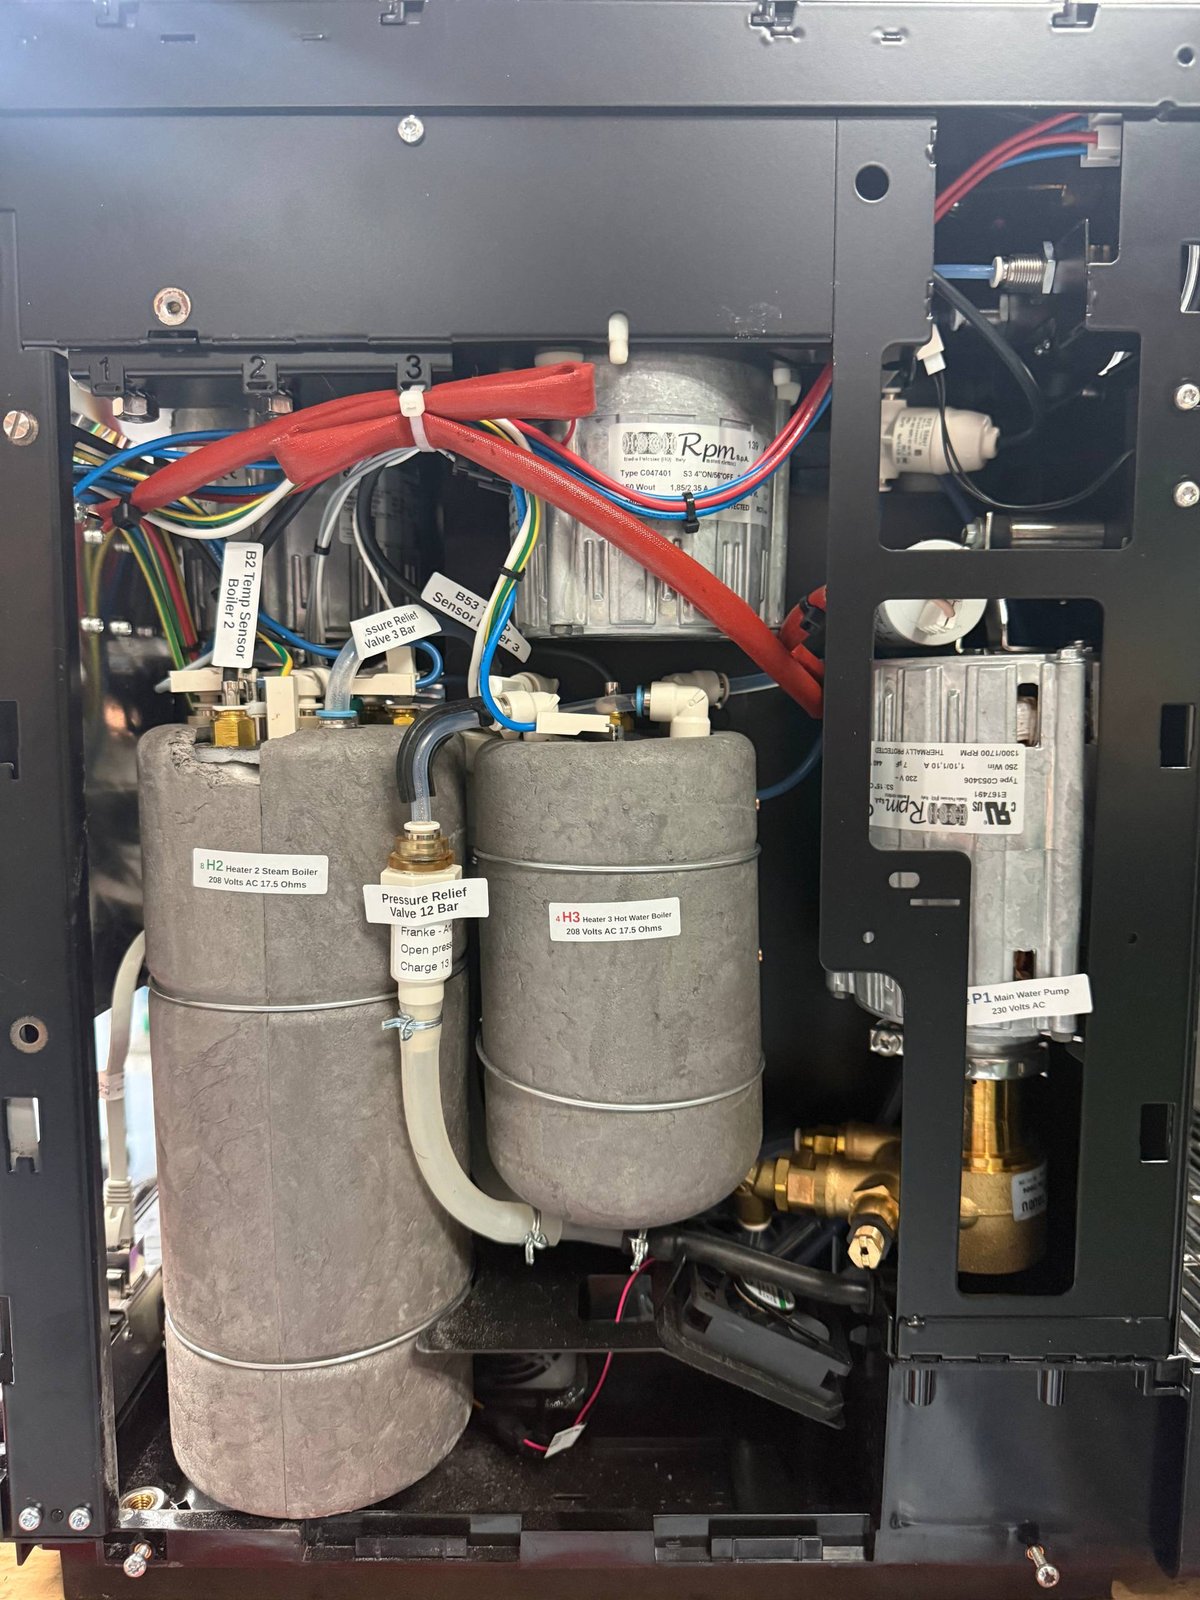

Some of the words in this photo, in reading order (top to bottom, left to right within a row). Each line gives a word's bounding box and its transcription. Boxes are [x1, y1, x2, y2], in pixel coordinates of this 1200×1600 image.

[101, 356, 110, 380] 1
[250, 354, 266, 379] 2
[406, 354, 422, 379] 3
[678, 432, 736, 462] Rpm
[620, 470, 638, 478] Type
[670, 484, 702, 492] 1,85/2,35
[245, 551, 256, 568] B2
[239, 573, 255, 606] Temp
[225, 578, 239, 618] Boiler
[455, 590, 480, 610] B53
[432, 592, 476, 624] Sensor
[364, 621, 393, 636] ssure
[393, 610, 419, 626] Relief
[236, 612, 251, 659] Sensor
[364, 634, 390, 650] Valve
[393, 630, 400, 639] 3
[400, 624, 416, 636] Bar
[512, 643, 520, 652] 3
[980, 749, 1019, 757] 1300/1700
[930, 762, 964, 770] 1,10/1,10
[1000, 777, 1018, 785] Type
[885, 796, 926, 824] Rpm
[972, 802, 983, 812] US
[206, 858, 224, 872] H2
[226, 865, 252, 874] Heater
[262, 868, 290, 876] Steam
[292, 868, 318, 876] Boiler
[208, 876, 222, 884] 208
[224, 878, 244, 886] Volts
[246, 879, 258, 887] AC
[280, 880, 307, 888] Ohms
[382, 893, 428, 906] Pressure
[432, 886, 468, 902] Relief
[390, 907, 416, 918] Valve
[420, 906, 434, 917] 12
[438, 902, 459, 914] Bar
[562, 911, 580, 923] H3
[629, 914, 650, 922] Water
[652, 912, 672, 920] Boiler
[401, 926, 436, 936] Franke
[619, 926, 637, 934] 17.5
[638, 924, 662, 933] Ohms
[400, 944, 429, 955] Open
[400, 961, 438, 974] Charge
[441, 959, 450, 969] 13
[972, 992, 992, 1004] P1
[994, 993, 1015, 1002] Main
[1016, 990, 1041, 999] Water
[1044, 988, 1070, 996] Pump
[992, 1006, 1007, 1015] 230
[1008, 1004, 1030, 1012] Volts
